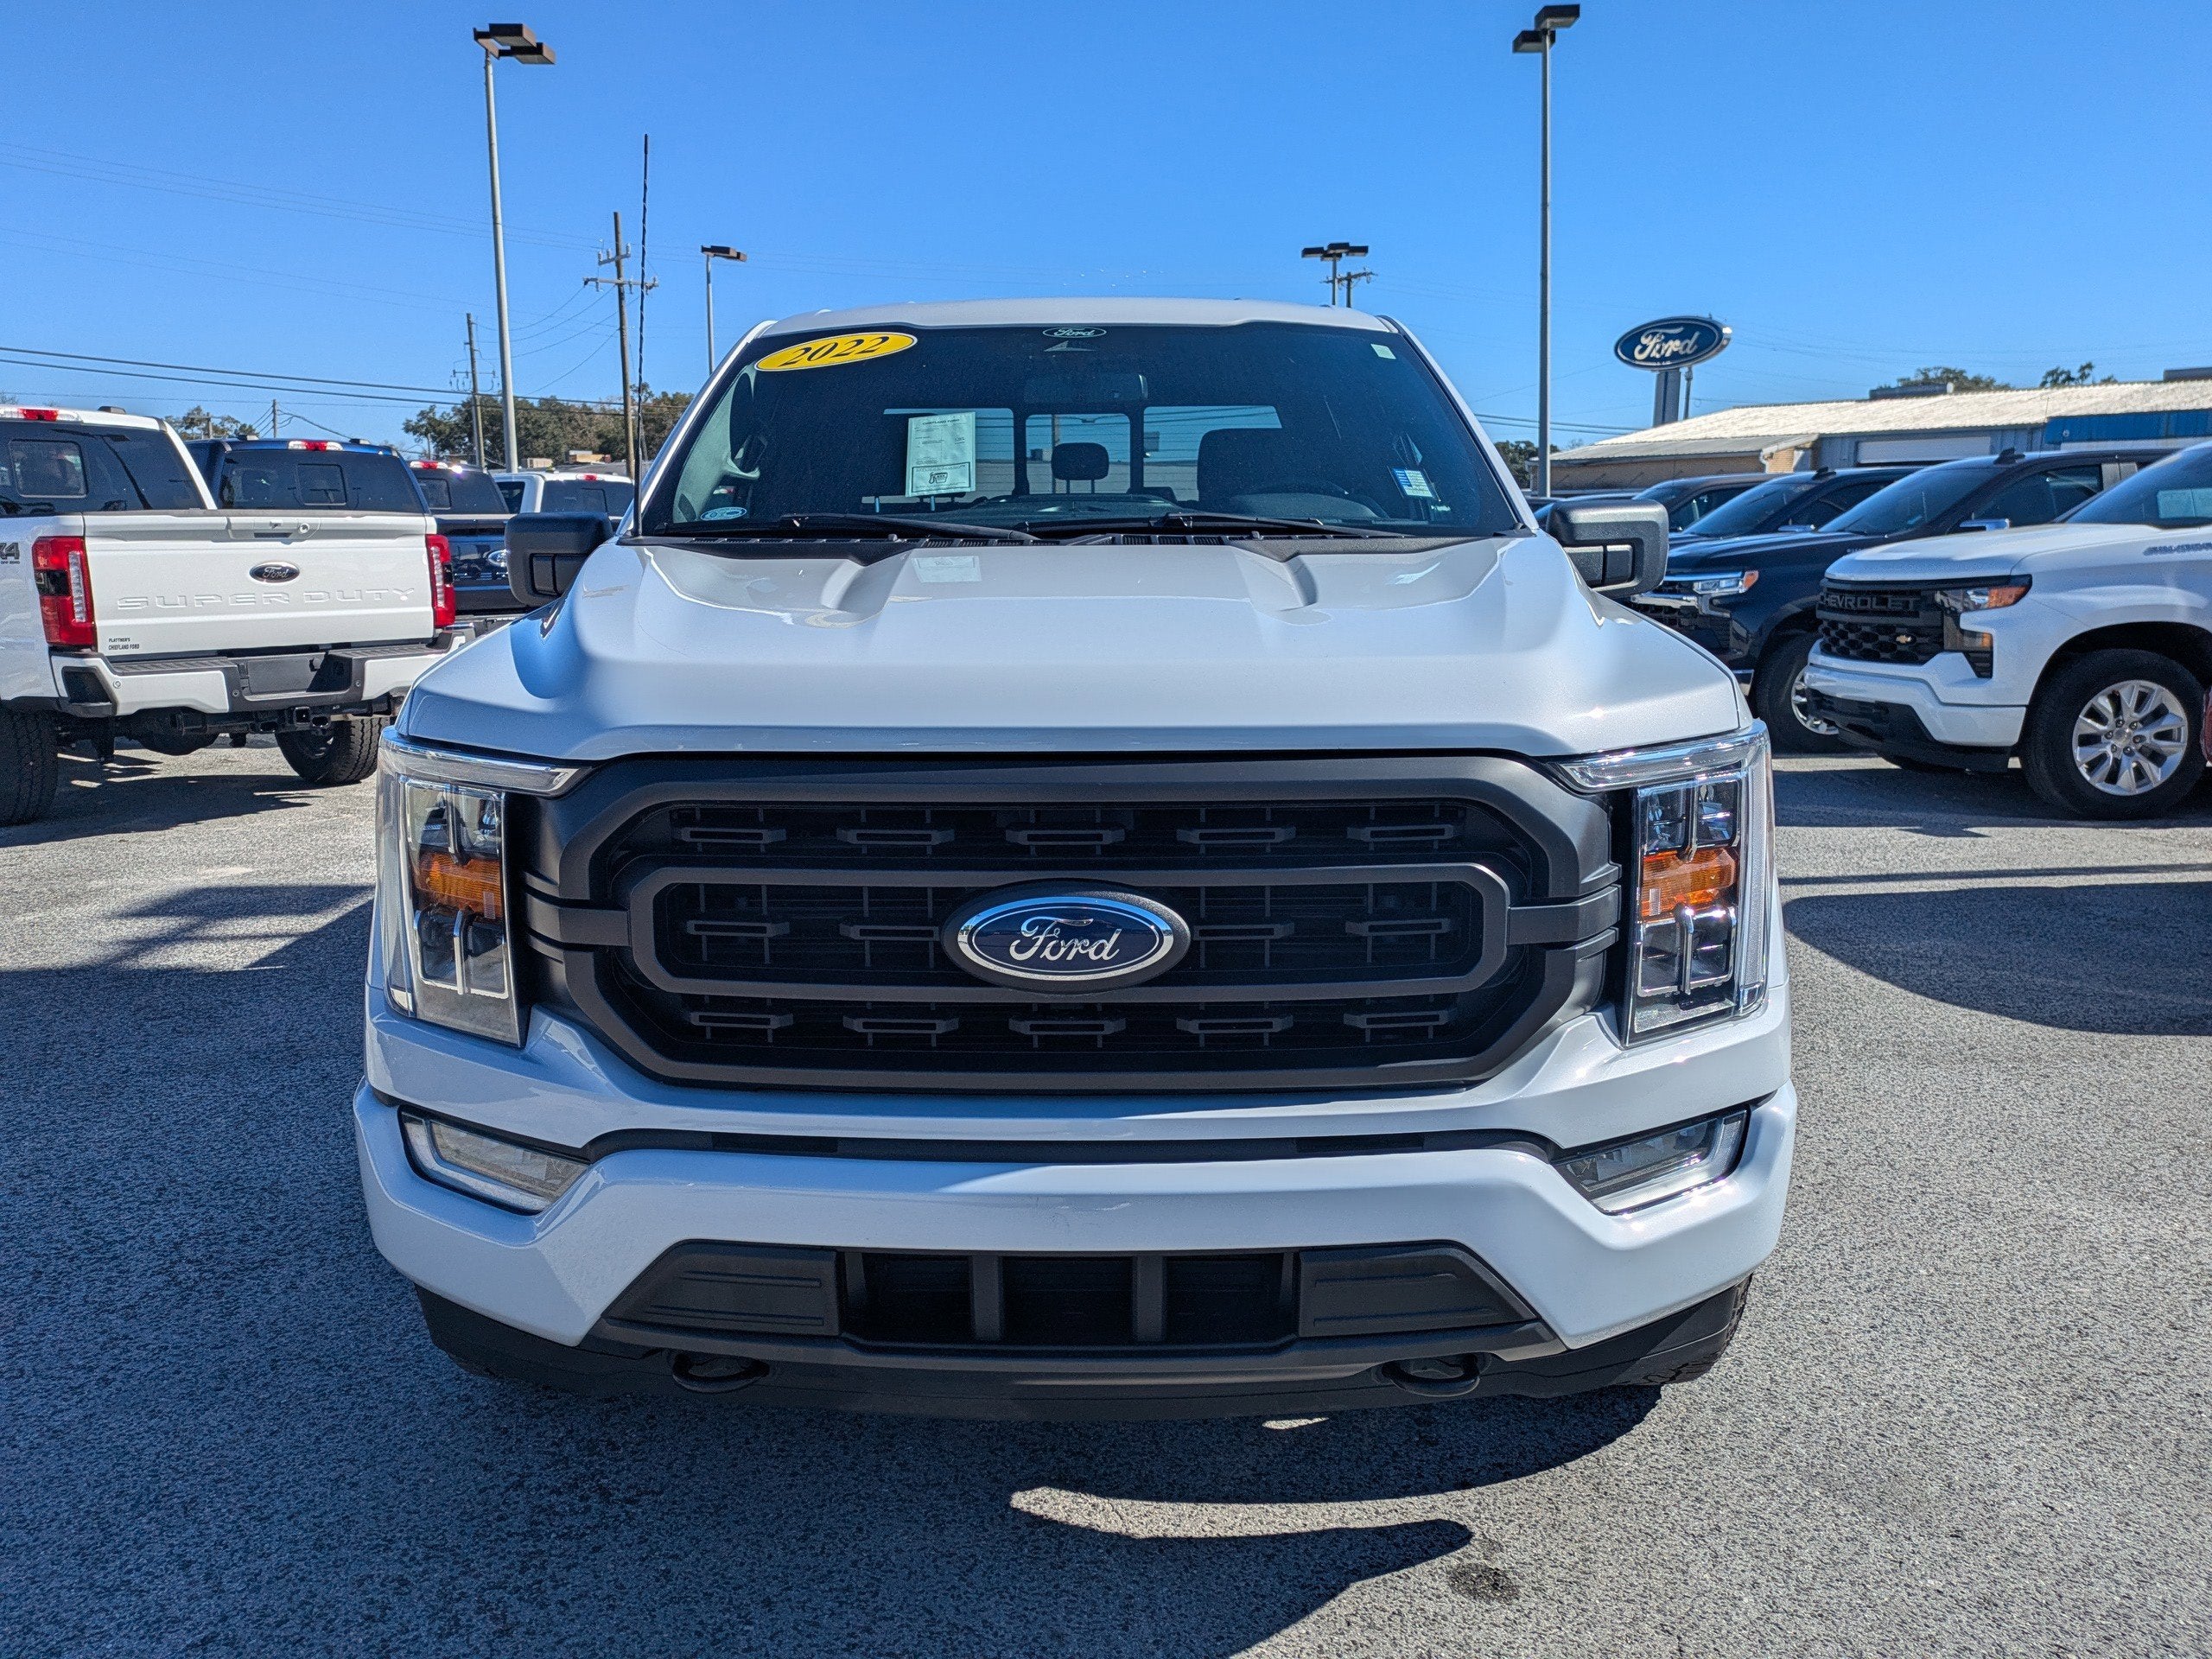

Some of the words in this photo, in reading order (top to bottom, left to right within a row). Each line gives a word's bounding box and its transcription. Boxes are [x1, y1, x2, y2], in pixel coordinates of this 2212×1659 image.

[1054, 327, 1096, 336] Ford
[1633, 326, 1700, 360] Ford
[778, 335, 890, 366] 2022
[262, 565, 289, 579] Ford
[118, 591, 290, 610] SUPER
[303, 587, 415, 603] DUTY
[1009, 916, 1122, 961] Ford
